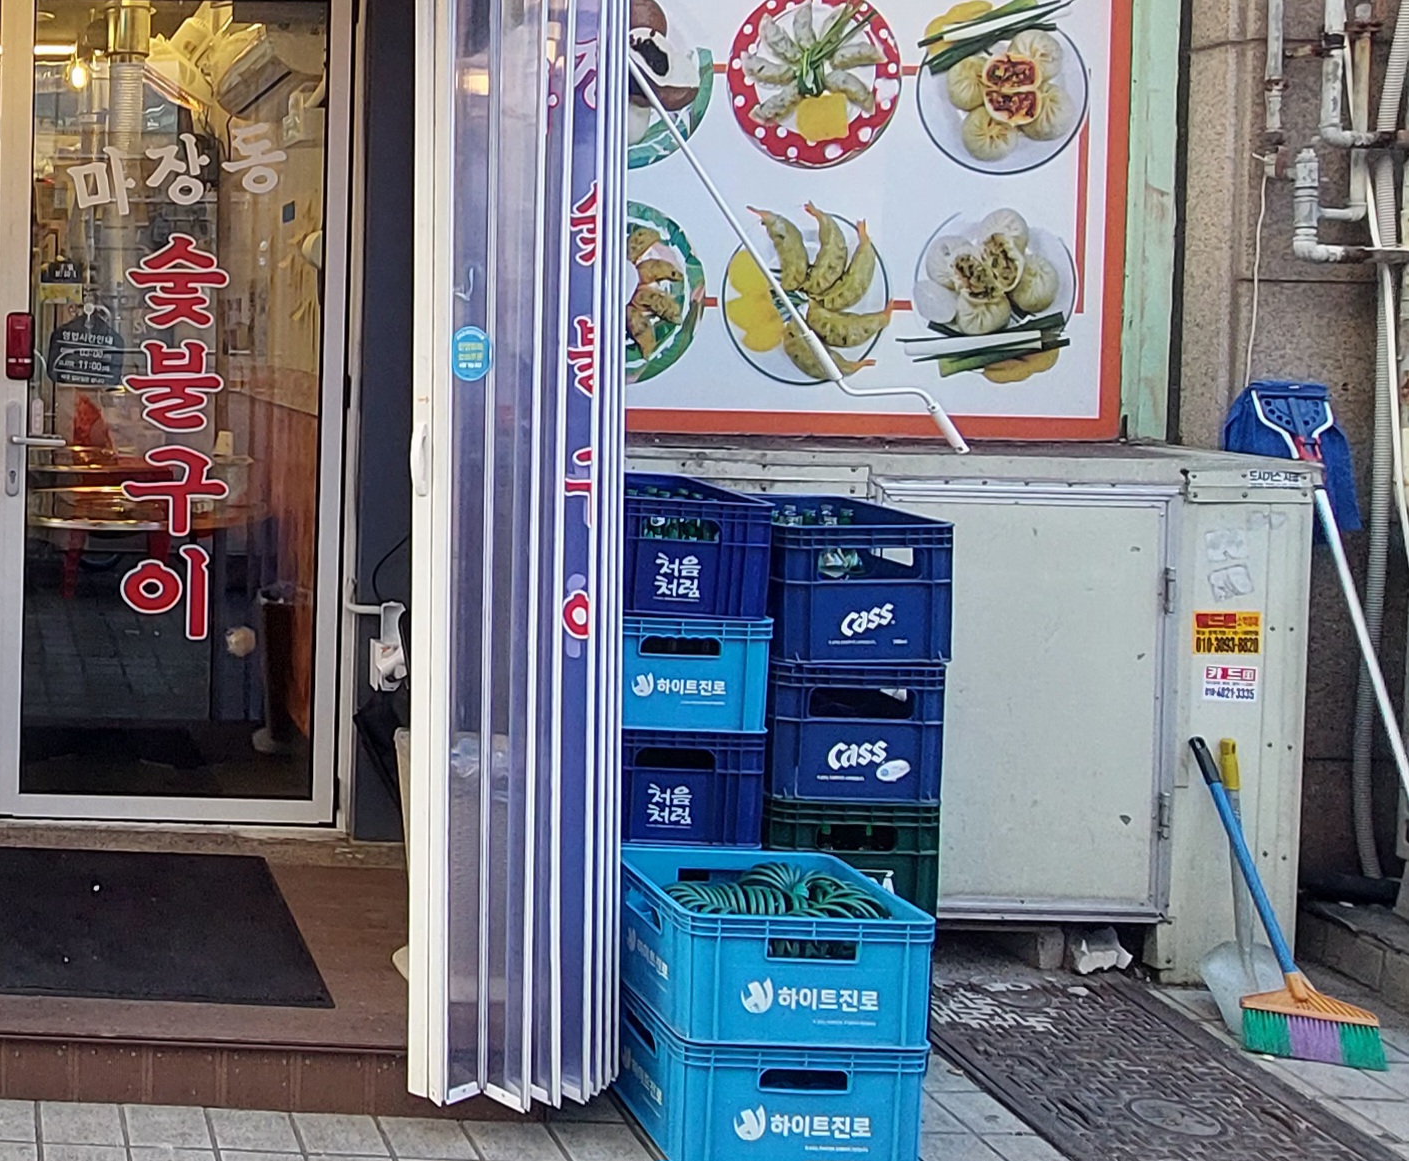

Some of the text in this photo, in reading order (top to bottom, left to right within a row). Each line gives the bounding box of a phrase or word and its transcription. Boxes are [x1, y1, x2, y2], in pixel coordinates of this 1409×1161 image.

[67, 123, 287, 216] 마장동
[120, 232, 229, 641] 숯불구이
[655, 552, 701, 577] 처음
[654, 576, 701, 598] 처럼
[656, 678, 727, 696] 하이트진로
[648, 783, 693, 805] 처음
[646, 804, 692, 825] 처럼
[777, 987, 879, 1012] 하이트진로
[770, 1114, 871, 1139] 하이트진로
